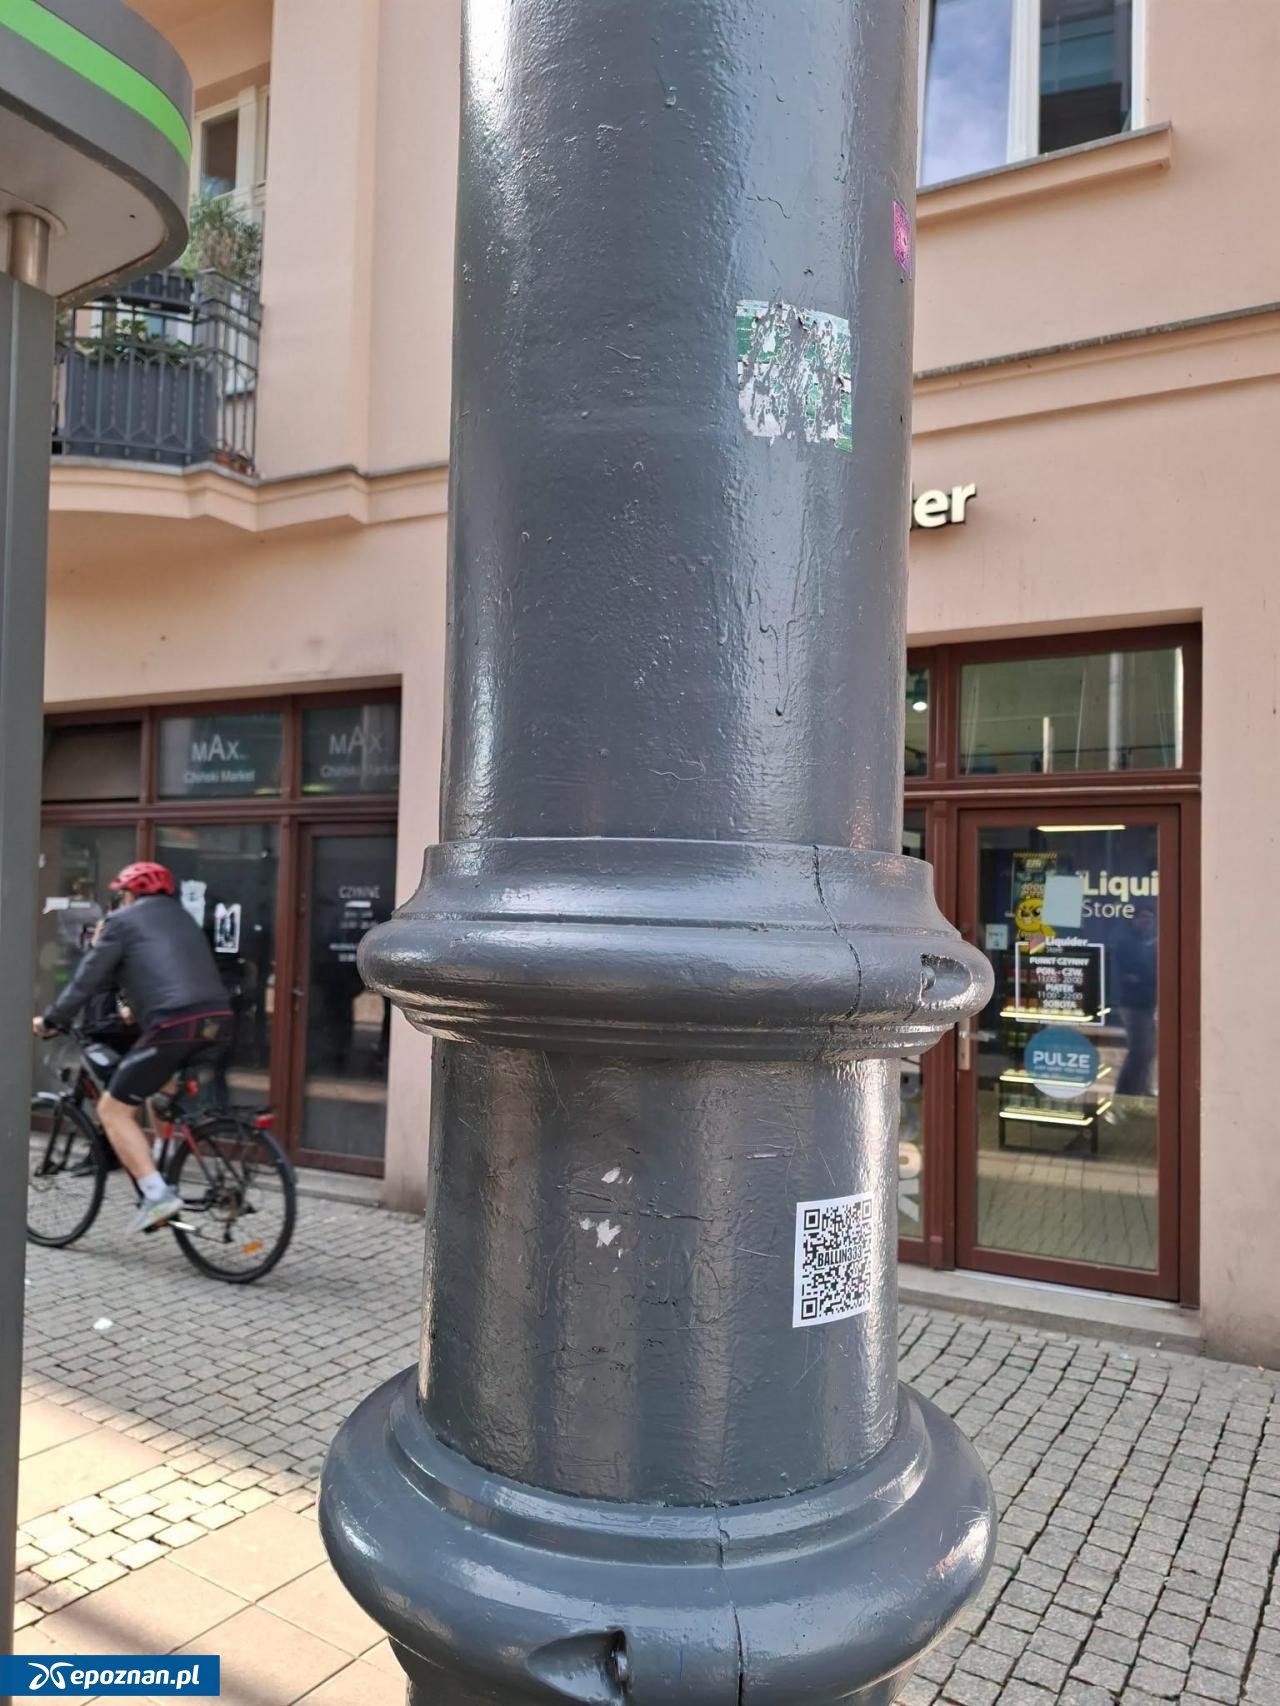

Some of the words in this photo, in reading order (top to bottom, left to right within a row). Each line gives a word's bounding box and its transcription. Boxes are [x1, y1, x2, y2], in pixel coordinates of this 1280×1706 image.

[192, 734, 240, 761] MAX
[328, 726, 383, 754] MAX
[1081, 899, 1136, 919] Store
[1045, 935, 1088, 948] Liquider
[1043, 999, 1077, 1009] SOBOTA
[1032, 1050, 1091, 1069] PULZE
[817, 1244, 863, 1268] BALLIN333
